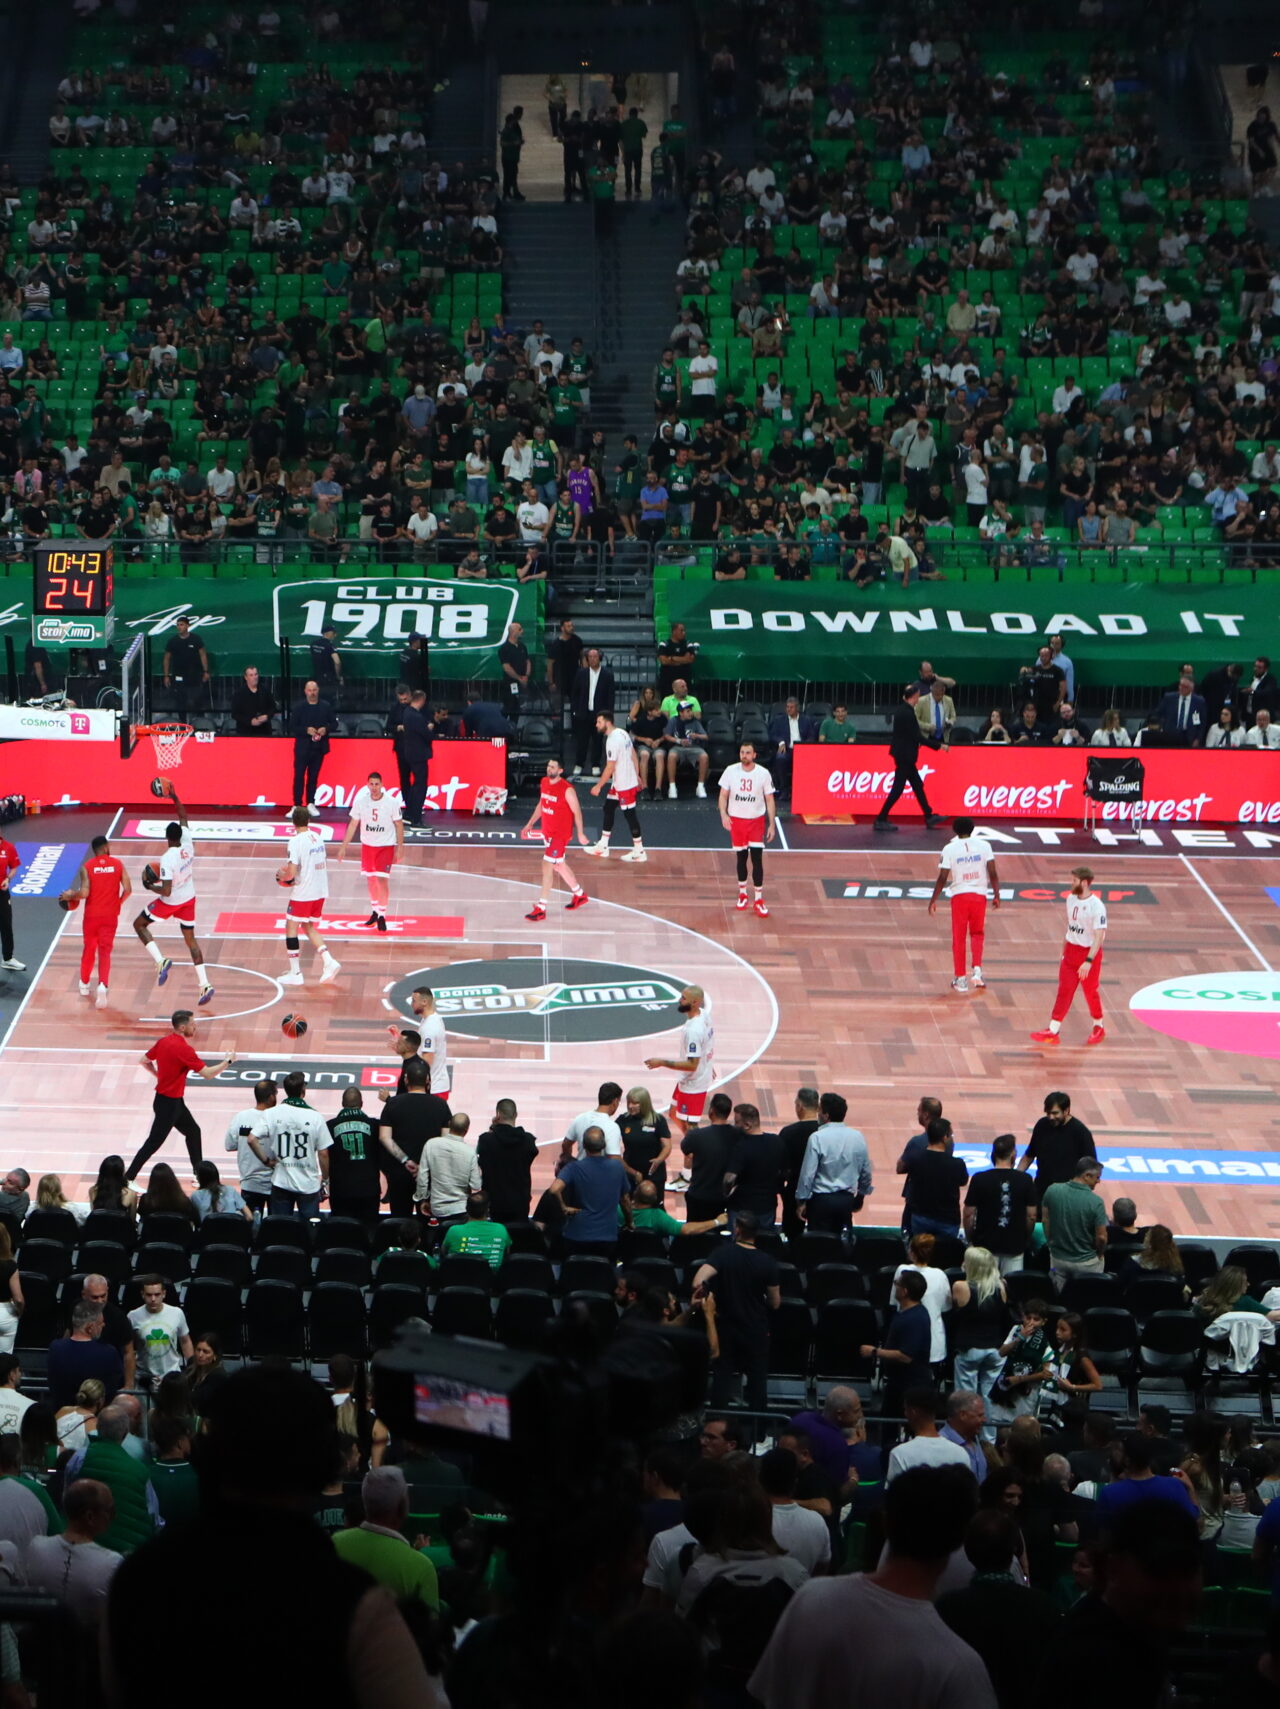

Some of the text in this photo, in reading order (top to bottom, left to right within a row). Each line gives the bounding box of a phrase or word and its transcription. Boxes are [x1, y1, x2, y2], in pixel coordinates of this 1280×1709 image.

[48, 553, 100, 574] 10:43
[45, 578, 94, 609] 24
[337, 586, 454, 601] CLUB
[125, 603, 227, 636] App
[300, 600, 488, 639] 1908
[710, 607, 1245, 637] DOWNLOAD IT
[20, 717, 66, 728] COSMOTE
[740, 778, 753, 792] 33
[827, 764, 935, 793] everet
[1099, 780, 1140, 792] SPALDING
[734, 794, 756, 803] bwin
[963, 779, 1073, 808] everest
[372, 808, 379, 822] 5
[1102, 793, 1213, 822] everest
[148, 826, 261, 834] CMOTE
[439, 986, 493, 998] pame
[1162, 989, 1280, 1002] COS
[277, 1131, 309, 1160] 08
[341, 1132, 365, 1160] 41
